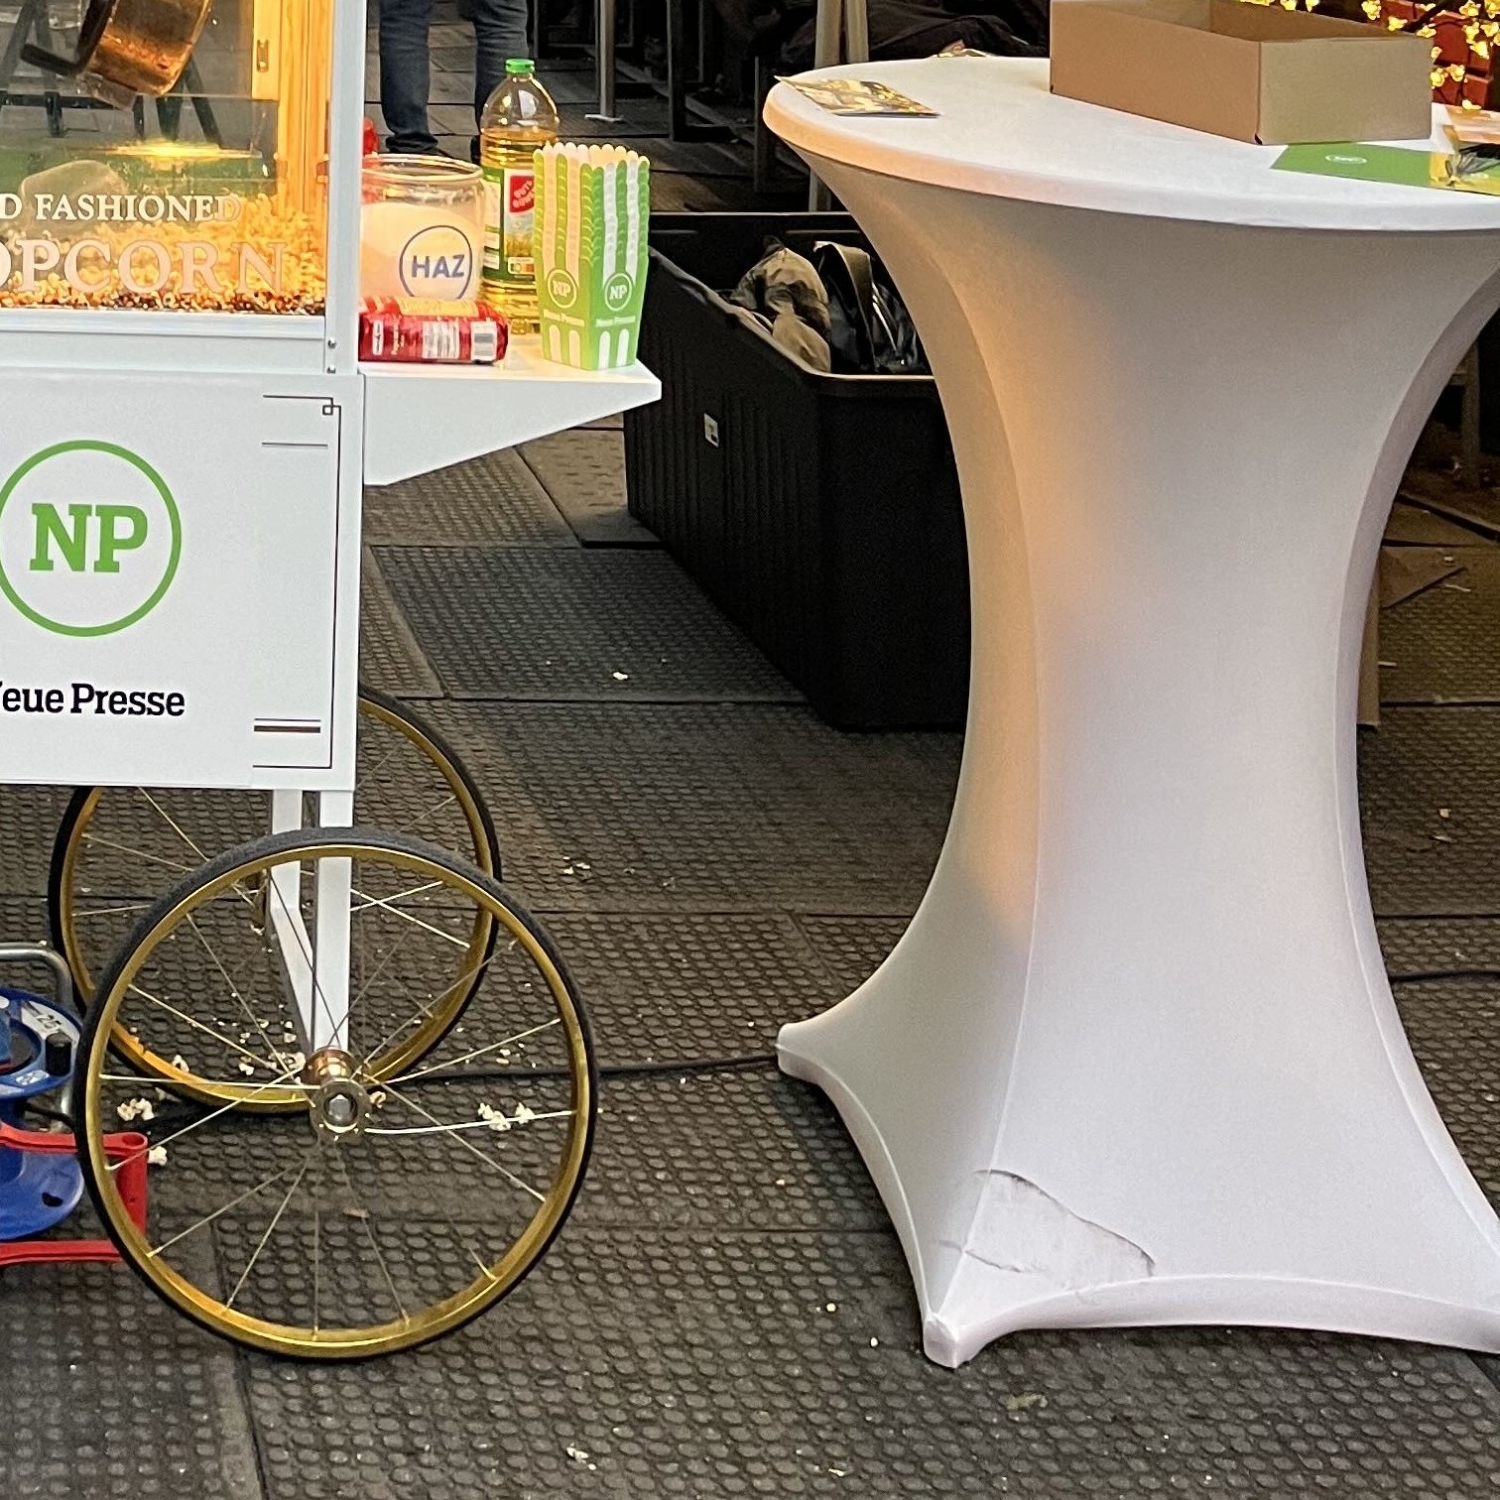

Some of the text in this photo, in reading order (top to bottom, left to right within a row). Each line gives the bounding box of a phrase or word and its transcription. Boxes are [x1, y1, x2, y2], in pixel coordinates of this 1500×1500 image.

[35, 193, 242, 223] FASHIONED
[411, 254, 465, 278] HAZ
[609, 284, 628, 301] NP
[29, 502, 149, 574] NP
[70, 682, 186, 717] Presse
